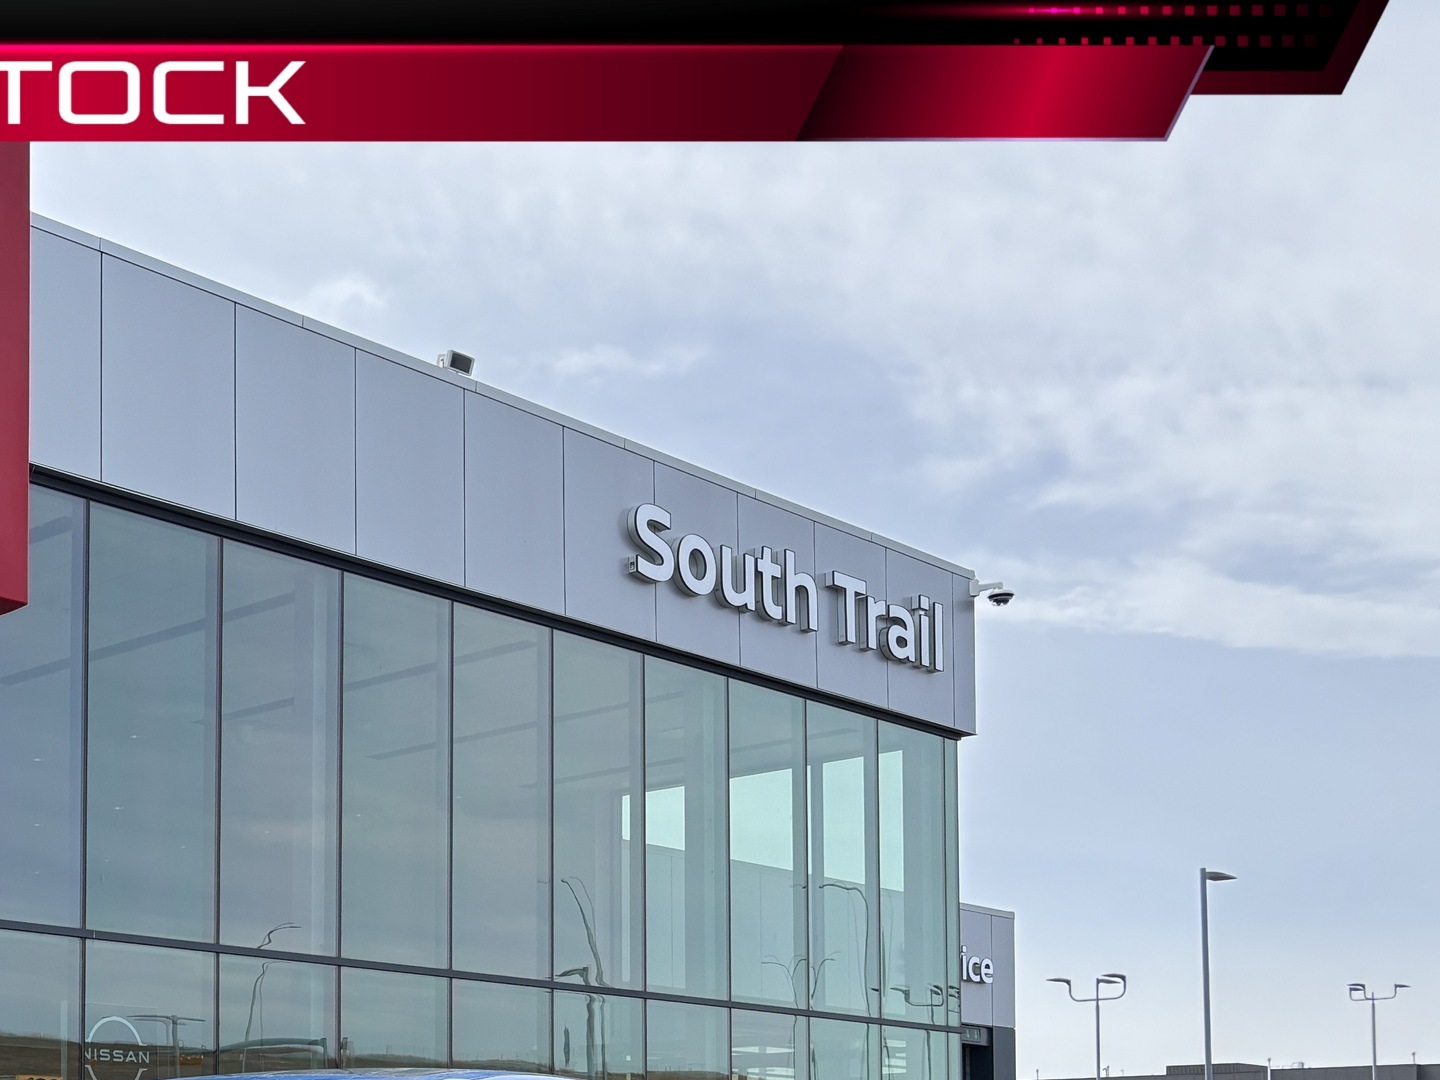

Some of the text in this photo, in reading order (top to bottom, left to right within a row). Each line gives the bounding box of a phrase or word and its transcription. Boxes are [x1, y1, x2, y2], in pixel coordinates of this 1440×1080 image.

[630, 503, 943, 672] South Trail
[85, 1047, 149, 1064] NISSAN
